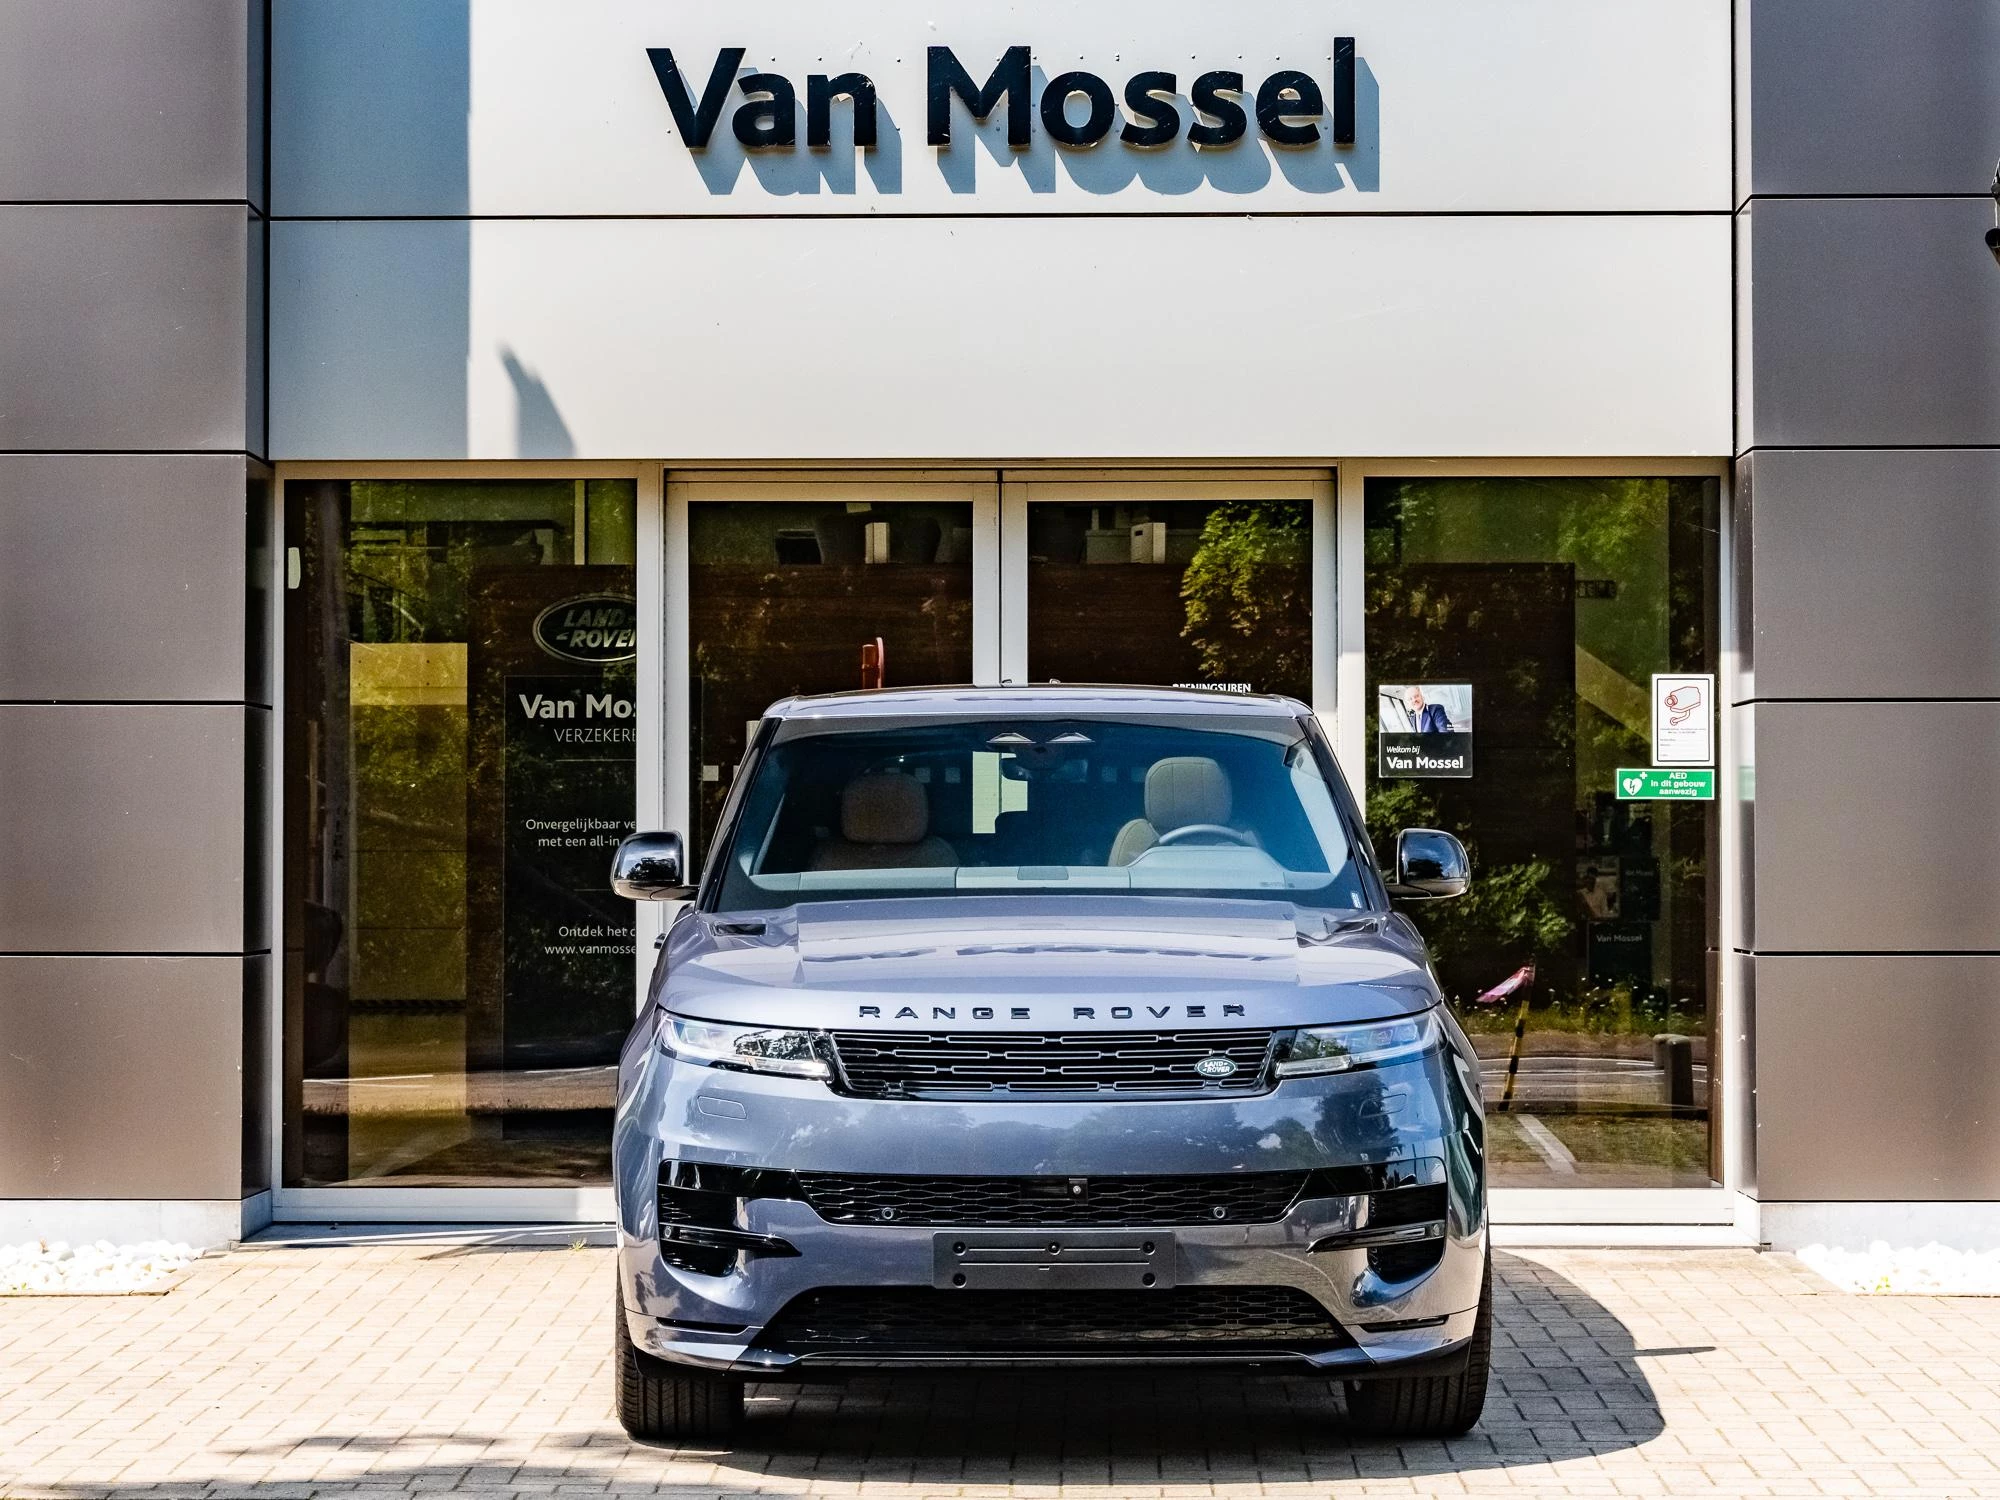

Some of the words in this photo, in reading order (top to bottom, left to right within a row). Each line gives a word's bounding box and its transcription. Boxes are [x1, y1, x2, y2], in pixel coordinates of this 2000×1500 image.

[646, 47, 877, 148] Van
[927, 36, 1356, 149] Mossel
[519, 694, 575, 719] Van
[586, 694, 636, 719] Mo
[1386, 745, 1411, 755] Welkom
[1412, 745, 1421, 755] bij
[1386, 757, 1412, 769] Van
[1416, 755, 1464, 769] Mossel
[1668, 772, 1687, 780] AED
[1673, 779, 1706, 788] gebouw
[1659, 788, 1697, 797] aanwezig
[525, 818, 621, 832] Onvergelijkbaar
[538, 836, 562, 847] met
[565, 837, 587, 847] een
[589, 835, 620, 847] all-in
[558, 925, 604, 937] Ontdek
[607, 926, 627, 937] het
[859, 1005, 1030, 1020] RANGE
[1073, 1003, 1246, 1020] ROVER
